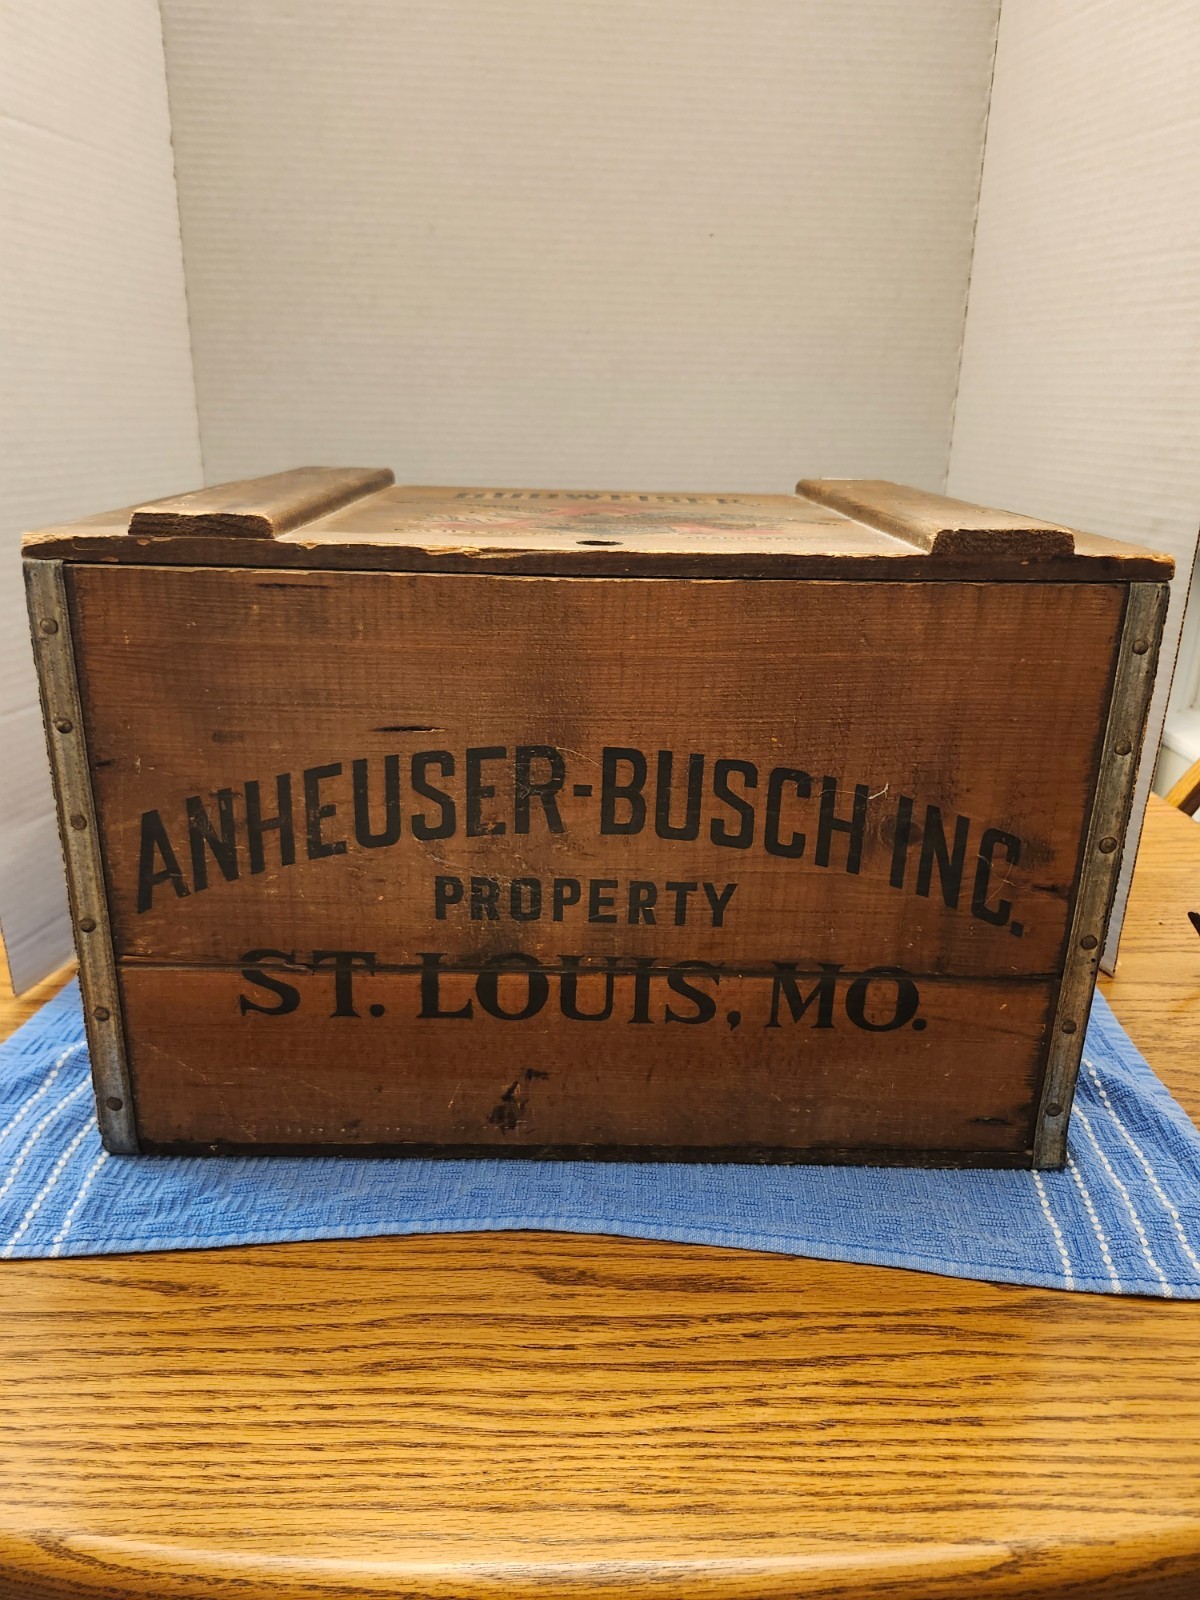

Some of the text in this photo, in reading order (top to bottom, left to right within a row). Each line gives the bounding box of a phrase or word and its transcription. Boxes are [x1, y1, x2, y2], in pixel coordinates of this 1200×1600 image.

[137, 745, 1025, 938] ANHEUSER-BUSCH INC.
[434, 875, 738, 928] PROPERTY
[238, 948, 386, 1018] ST.
[764, 962, 928, 1032] MO.
